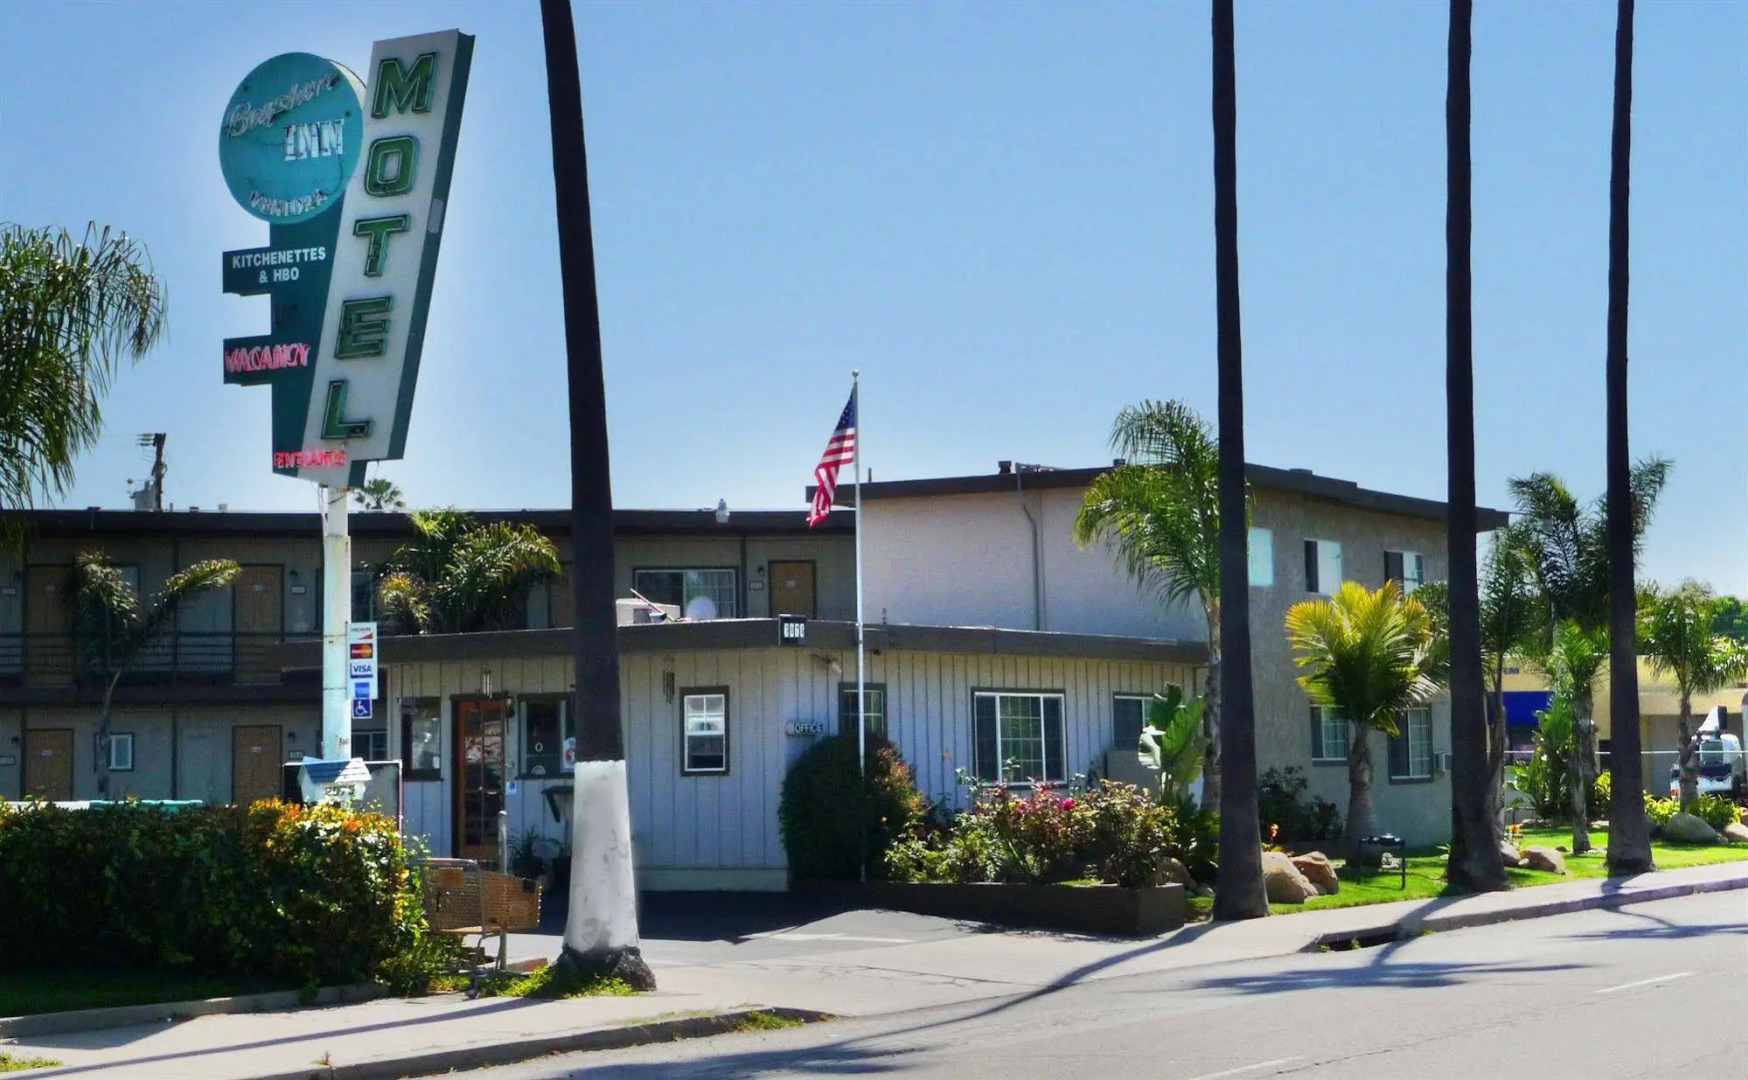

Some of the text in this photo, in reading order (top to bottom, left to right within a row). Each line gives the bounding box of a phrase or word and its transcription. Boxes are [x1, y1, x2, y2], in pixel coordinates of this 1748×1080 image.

[284, 119, 344, 161] INN
[320, 52, 438, 439] MOTEL
[232, 247, 326, 269] KITCHENETTES
[259, 267, 299, 283] & HBO
[225, 343, 311, 373] VACANCY
[274, 450, 347, 469] ENTRANCE
[353, 665, 372, 673] VISA
